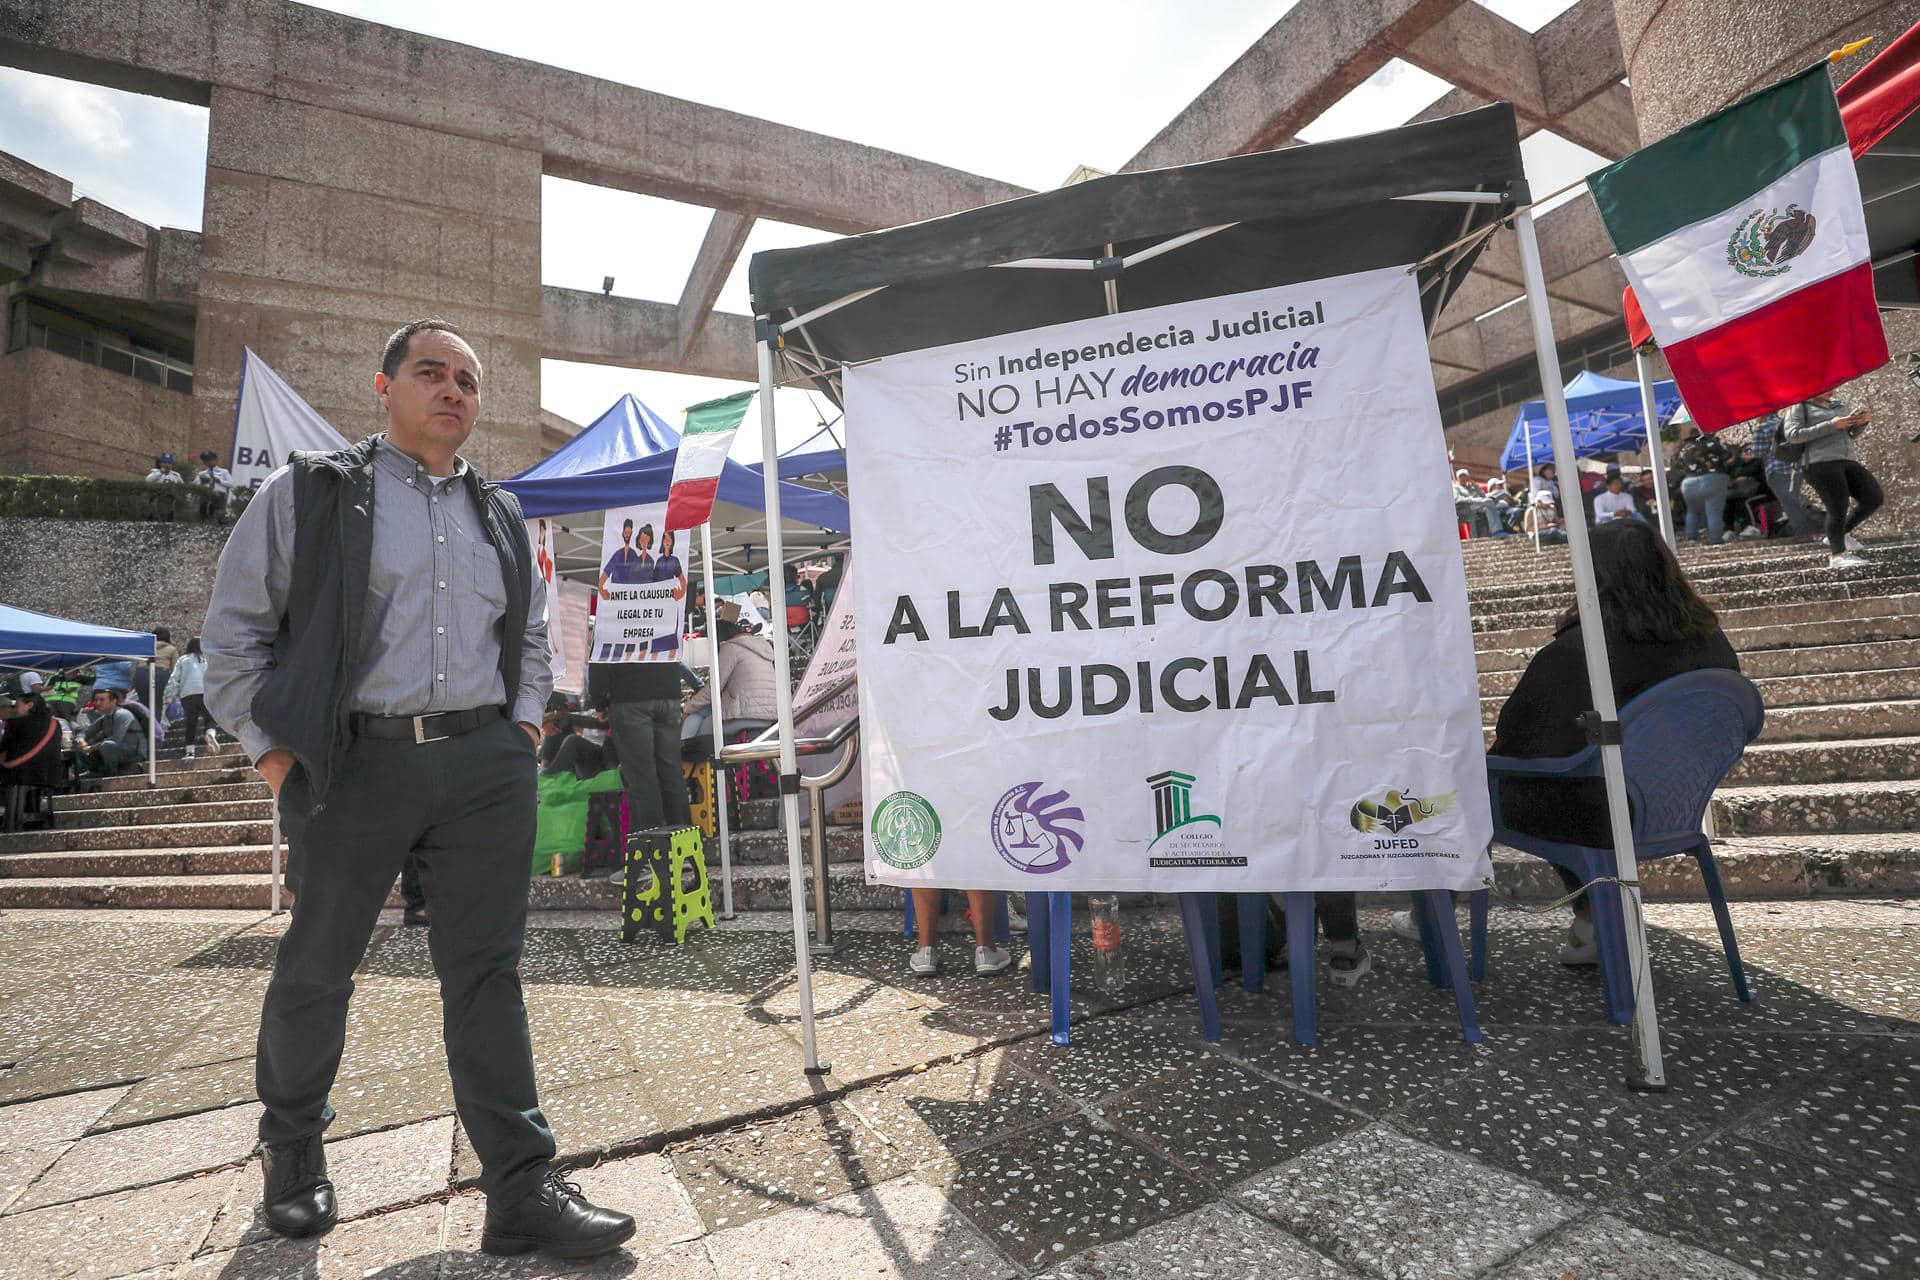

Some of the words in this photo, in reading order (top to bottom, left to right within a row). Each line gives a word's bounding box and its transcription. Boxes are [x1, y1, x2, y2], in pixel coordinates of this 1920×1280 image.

[954, 361, 991, 384] Sin
[999, 325, 1195, 377] Independecia
[1205, 302, 1327, 342] Judicial
[957, 384, 1021, 421] NO
[1035, 367, 1116, 409] HAY
[1119, 341, 1321, 398] democracia
[994, 381, 1313, 453] #TodosSomosPJF
[1028, 465, 1225, 566] NO
[610, 591, 628, 601] ANTE
[629, 590, 638, 600] LA
[639, 588, 675, 600] CLAUSURA
[617, 609, 641, 620] ILEGAL
[642, 608, 653, 619] DE
[654, 607, 664, 618] TU
[882, 594, 930, 645] A
[947, 587, 1032, 640] LA
[1048, 550, 1434, 633] REFORMA
[623, 627, 654, 639] EMPRESA
[987, 649, 1336, 722] JUDICIAL
[1374, 838, 1419, 850] JUFED
